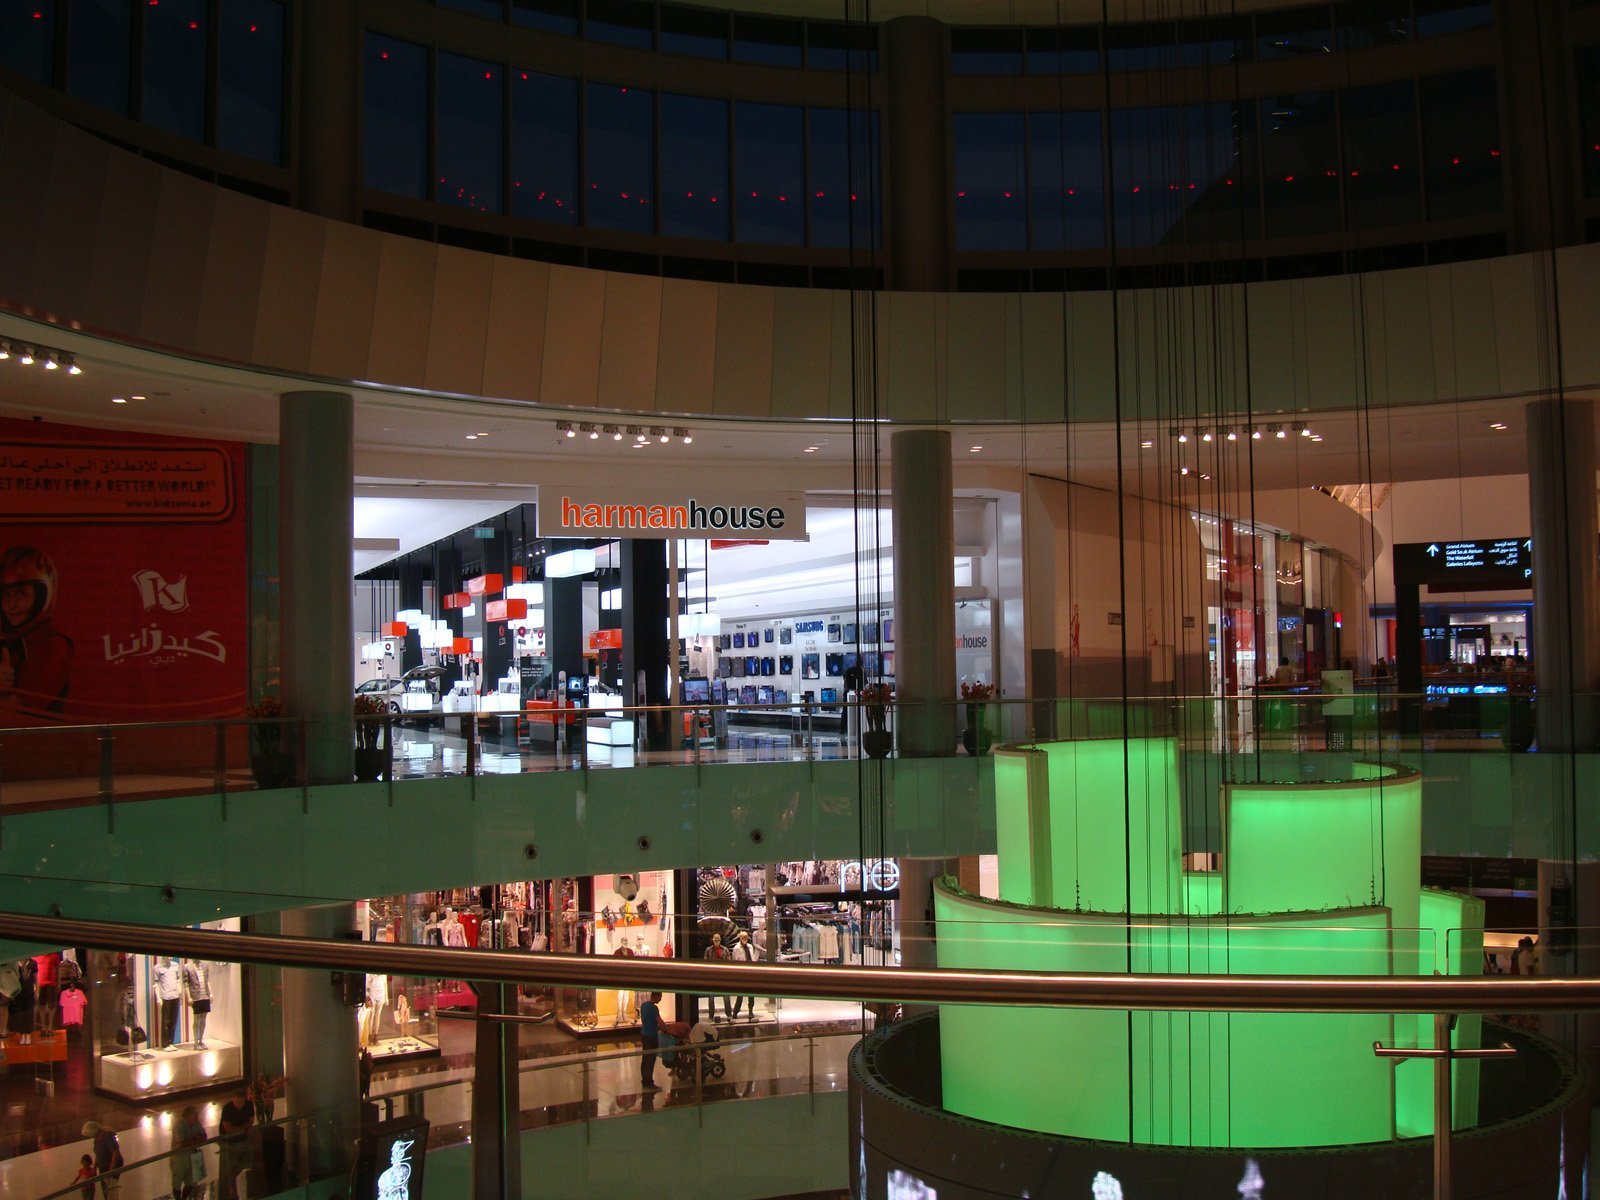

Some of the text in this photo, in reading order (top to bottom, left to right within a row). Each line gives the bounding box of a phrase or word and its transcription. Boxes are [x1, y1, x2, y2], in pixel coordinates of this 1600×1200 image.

[16, 478, 62, 491] READY
[65, 479, 91, 492] FOR
[93, 480, 102, 491] A
[107, 480, 156, 492] BETTER
[561, 496, 786, 529] harmanhouse
[795, 620, 824, 633] SAMSUNG
[102, 622, 227, 665] كيدزانيا
